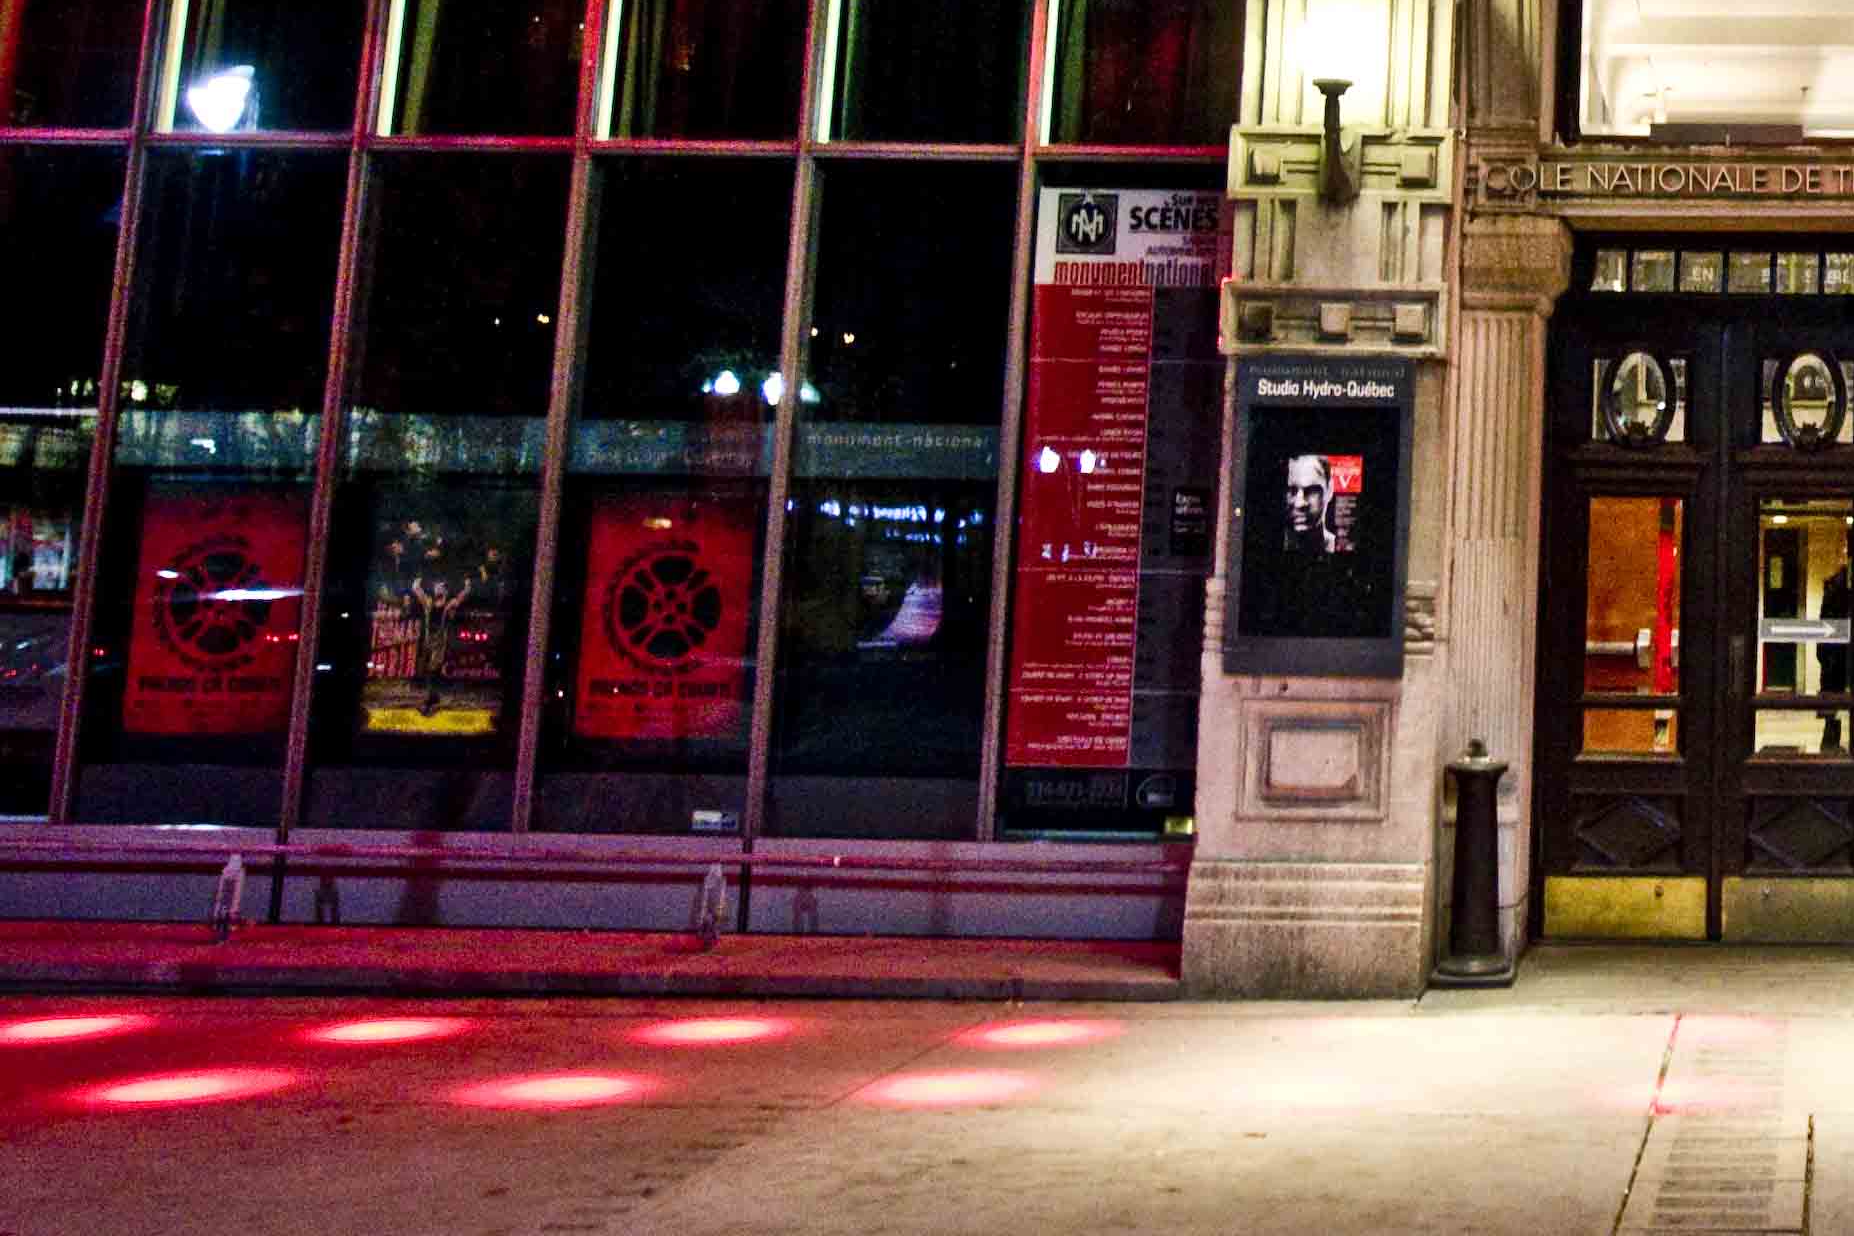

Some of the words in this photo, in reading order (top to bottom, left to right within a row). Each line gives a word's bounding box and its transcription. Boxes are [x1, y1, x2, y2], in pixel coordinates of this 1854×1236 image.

[1587, 164, 1770, 193] NATIONALE
[1781, 165, 1822, 194] DE
[1257, 377, 1300, 397] Studio
[1302, 379, 1395, 400] Hydro-Québec
